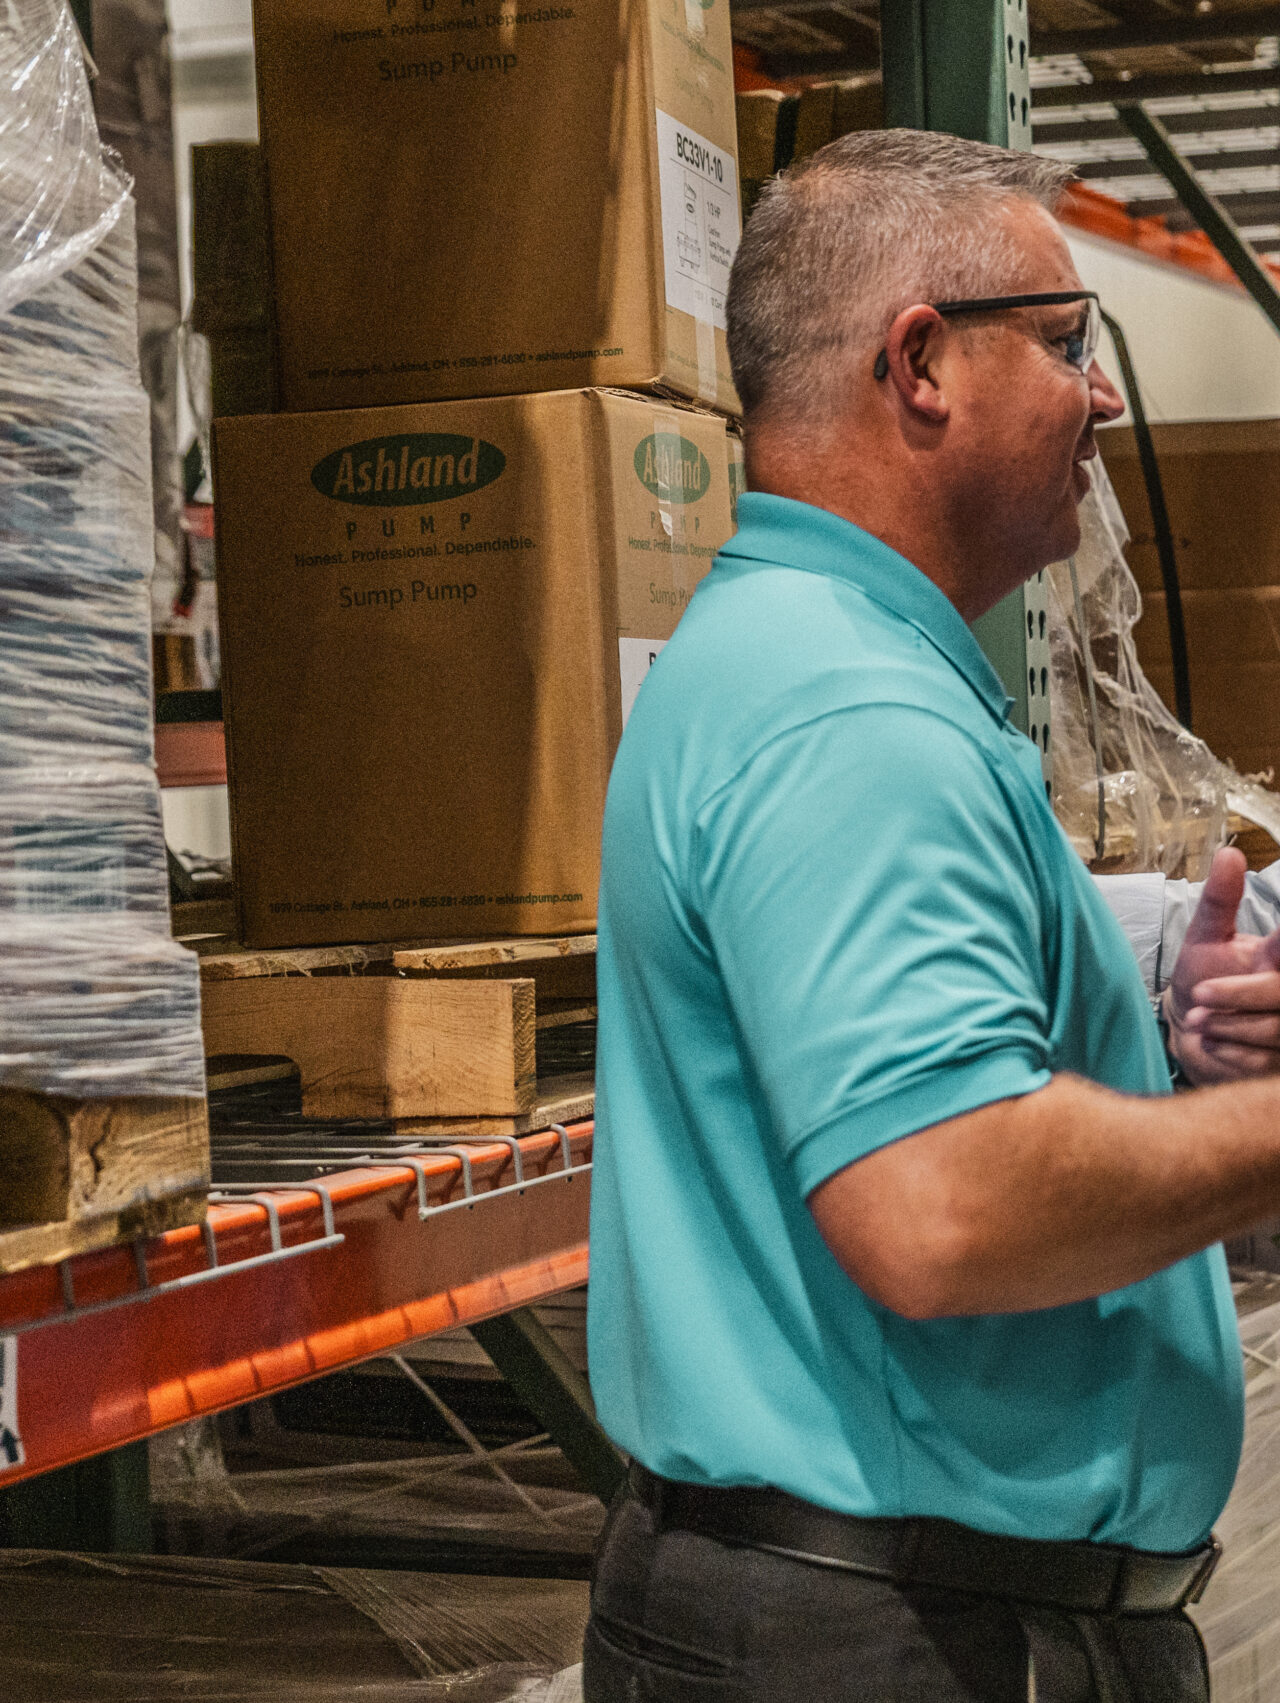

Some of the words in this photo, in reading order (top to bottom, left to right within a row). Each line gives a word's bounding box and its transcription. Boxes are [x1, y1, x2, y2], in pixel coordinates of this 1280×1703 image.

[391, 16, 479, 37] Professional.
[485, 7, 576, 28] Dependable.
[378, 59, 444, 82] Sump
[451, 52, 518, 75] Pump
[676, 132, 723, 183] BC33V1-10
[433, 358, 450, 369] OH
[535, 347, 624, 361] ashlandpump.com
[331, 437, 480, 495] Ashland
[643, 442, 701, 490] Ashland
[346, 512, 471, 540] PUMP
[294, 552, 348, 567] Honest.
[352, 544, 442, 563] Professional.
[445, 535, 536, 556] Dependable.
[338, 586, 404, 610] Sump
[411, 580, 477, 605] Pump
[649, 582, 676, 611] Sump
[392, 897, 410, 909] OH
[495, 892, 583, 905] ashlandpump.com
